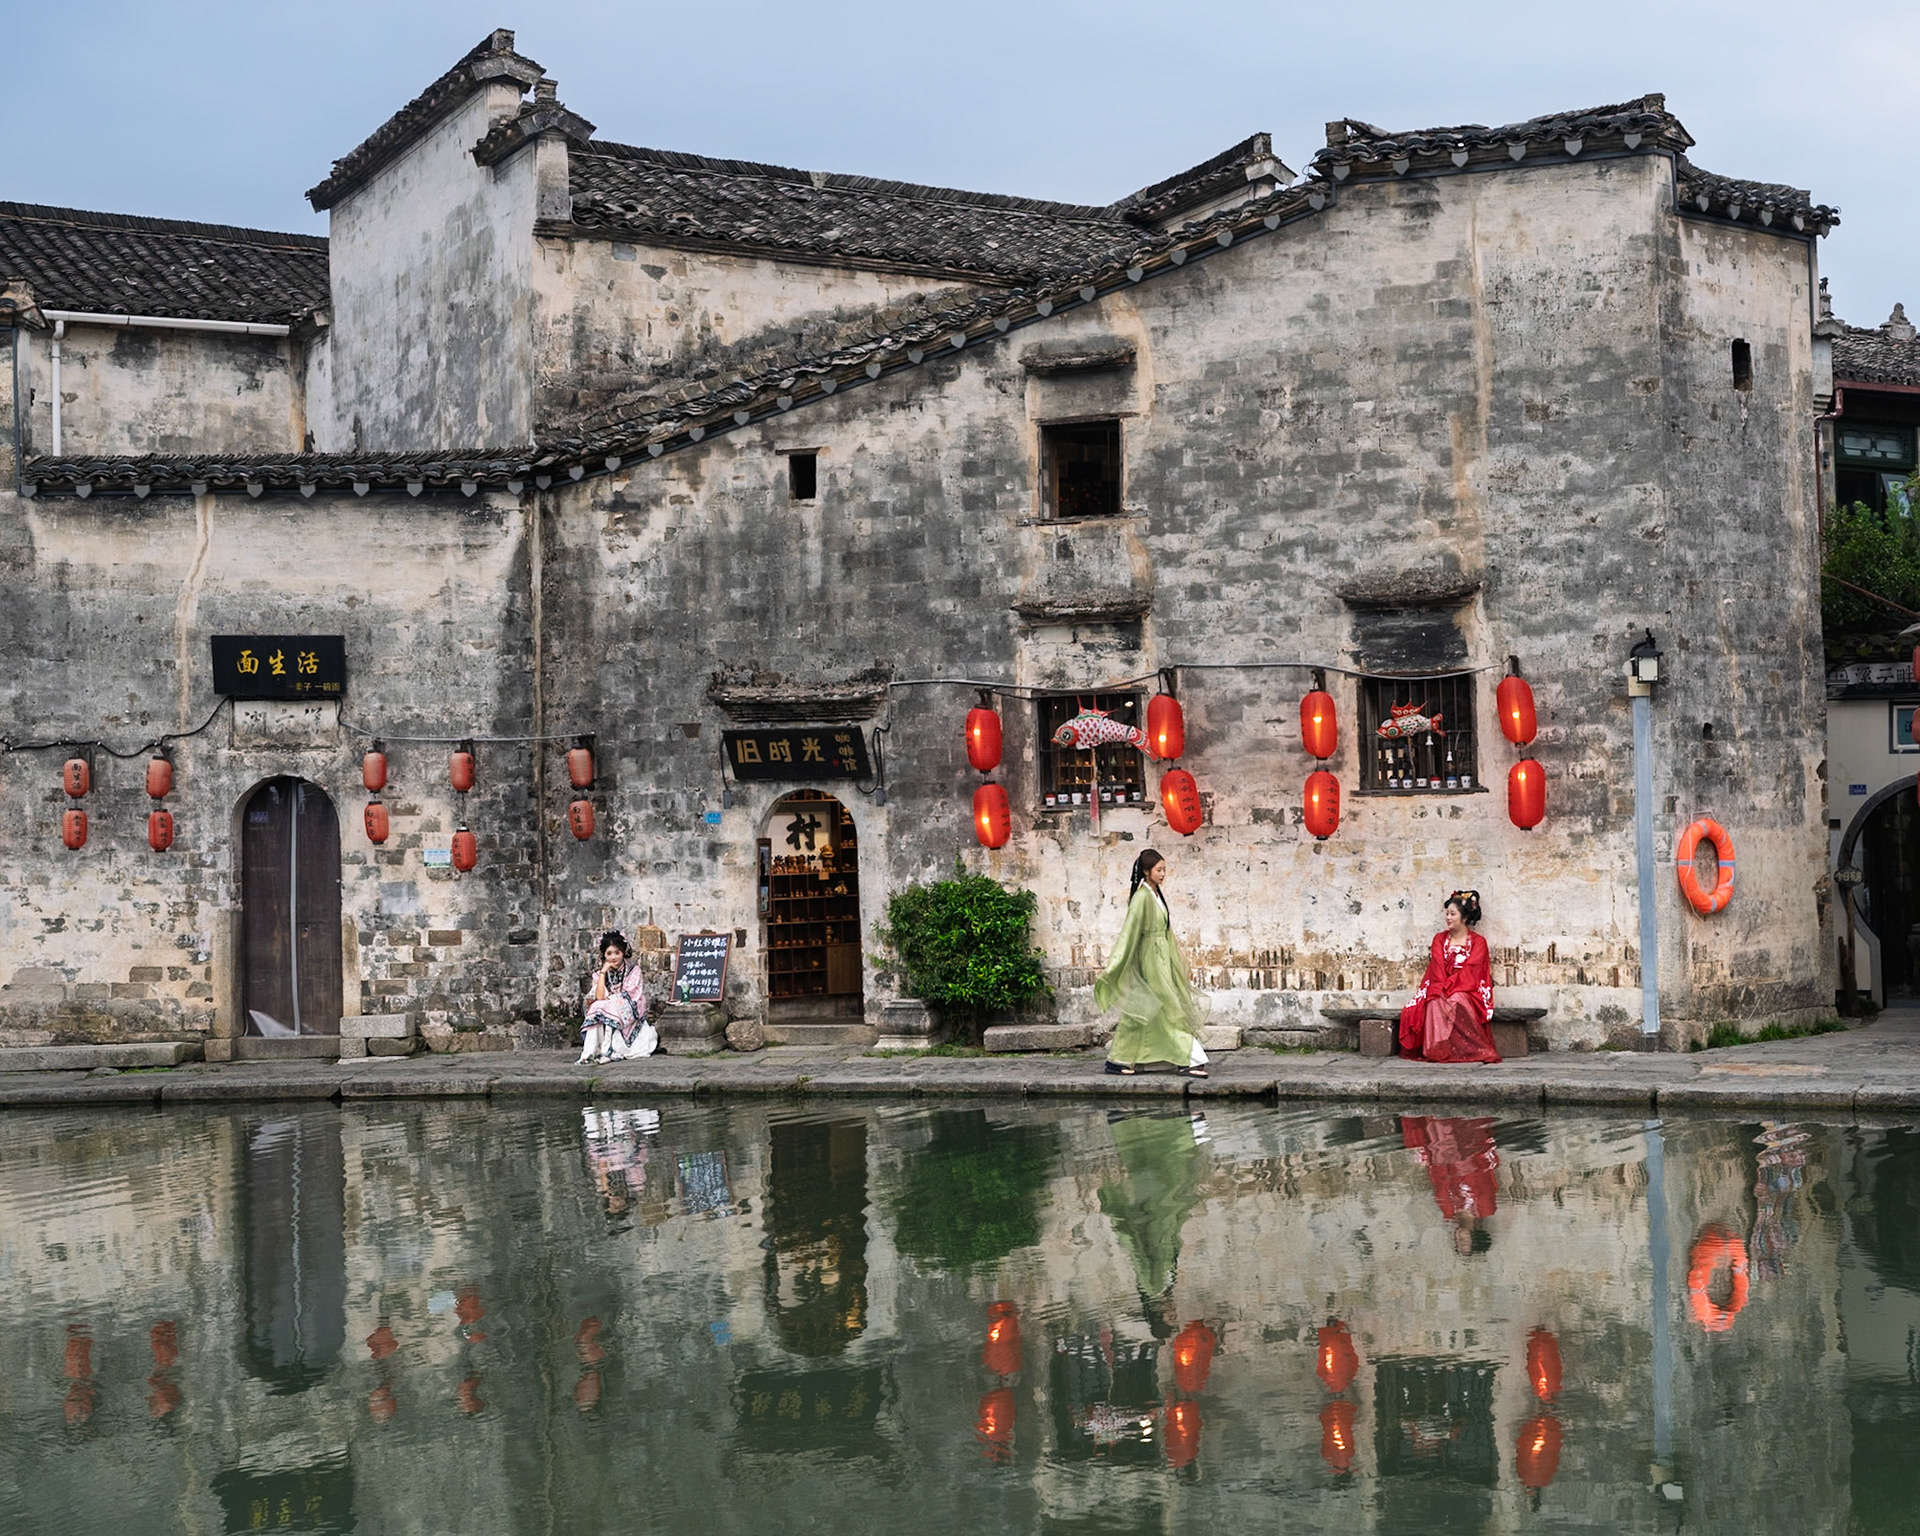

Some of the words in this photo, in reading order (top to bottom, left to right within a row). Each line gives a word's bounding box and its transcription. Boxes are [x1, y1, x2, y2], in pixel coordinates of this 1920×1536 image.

[236, 649, 320, 675] 面生活
[736, 736, 826, 763] 旧时光
[785, 812, 822, 851] 村
